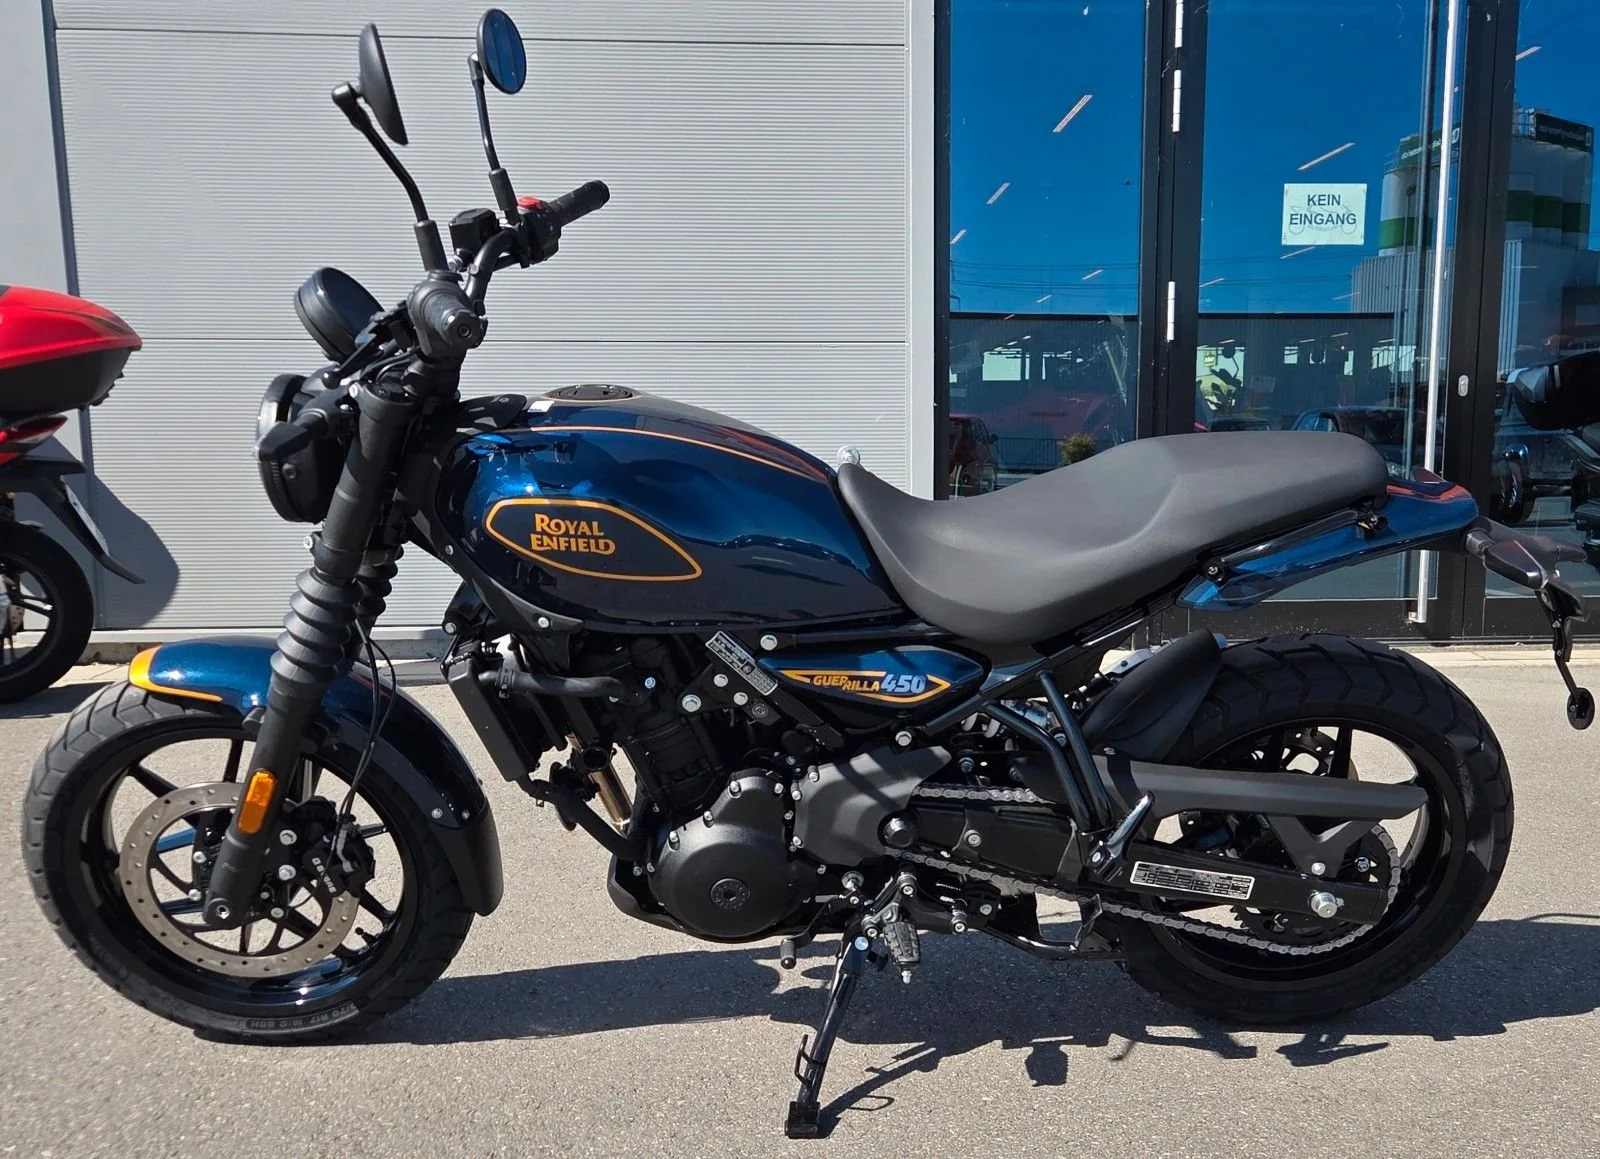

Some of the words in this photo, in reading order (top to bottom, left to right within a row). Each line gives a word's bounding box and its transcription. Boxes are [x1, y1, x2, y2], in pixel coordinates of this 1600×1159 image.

[1307, 194, 1341, 206] KEIN
[1289, 213, 1357, 225] EINGANG
[534, 513, 604, 536] ROYAL
[530, 533, 616, 555] ENFIELD
[813, 675, 880, 692] GUERRILLA
[880, 673, 926, 693] 450
